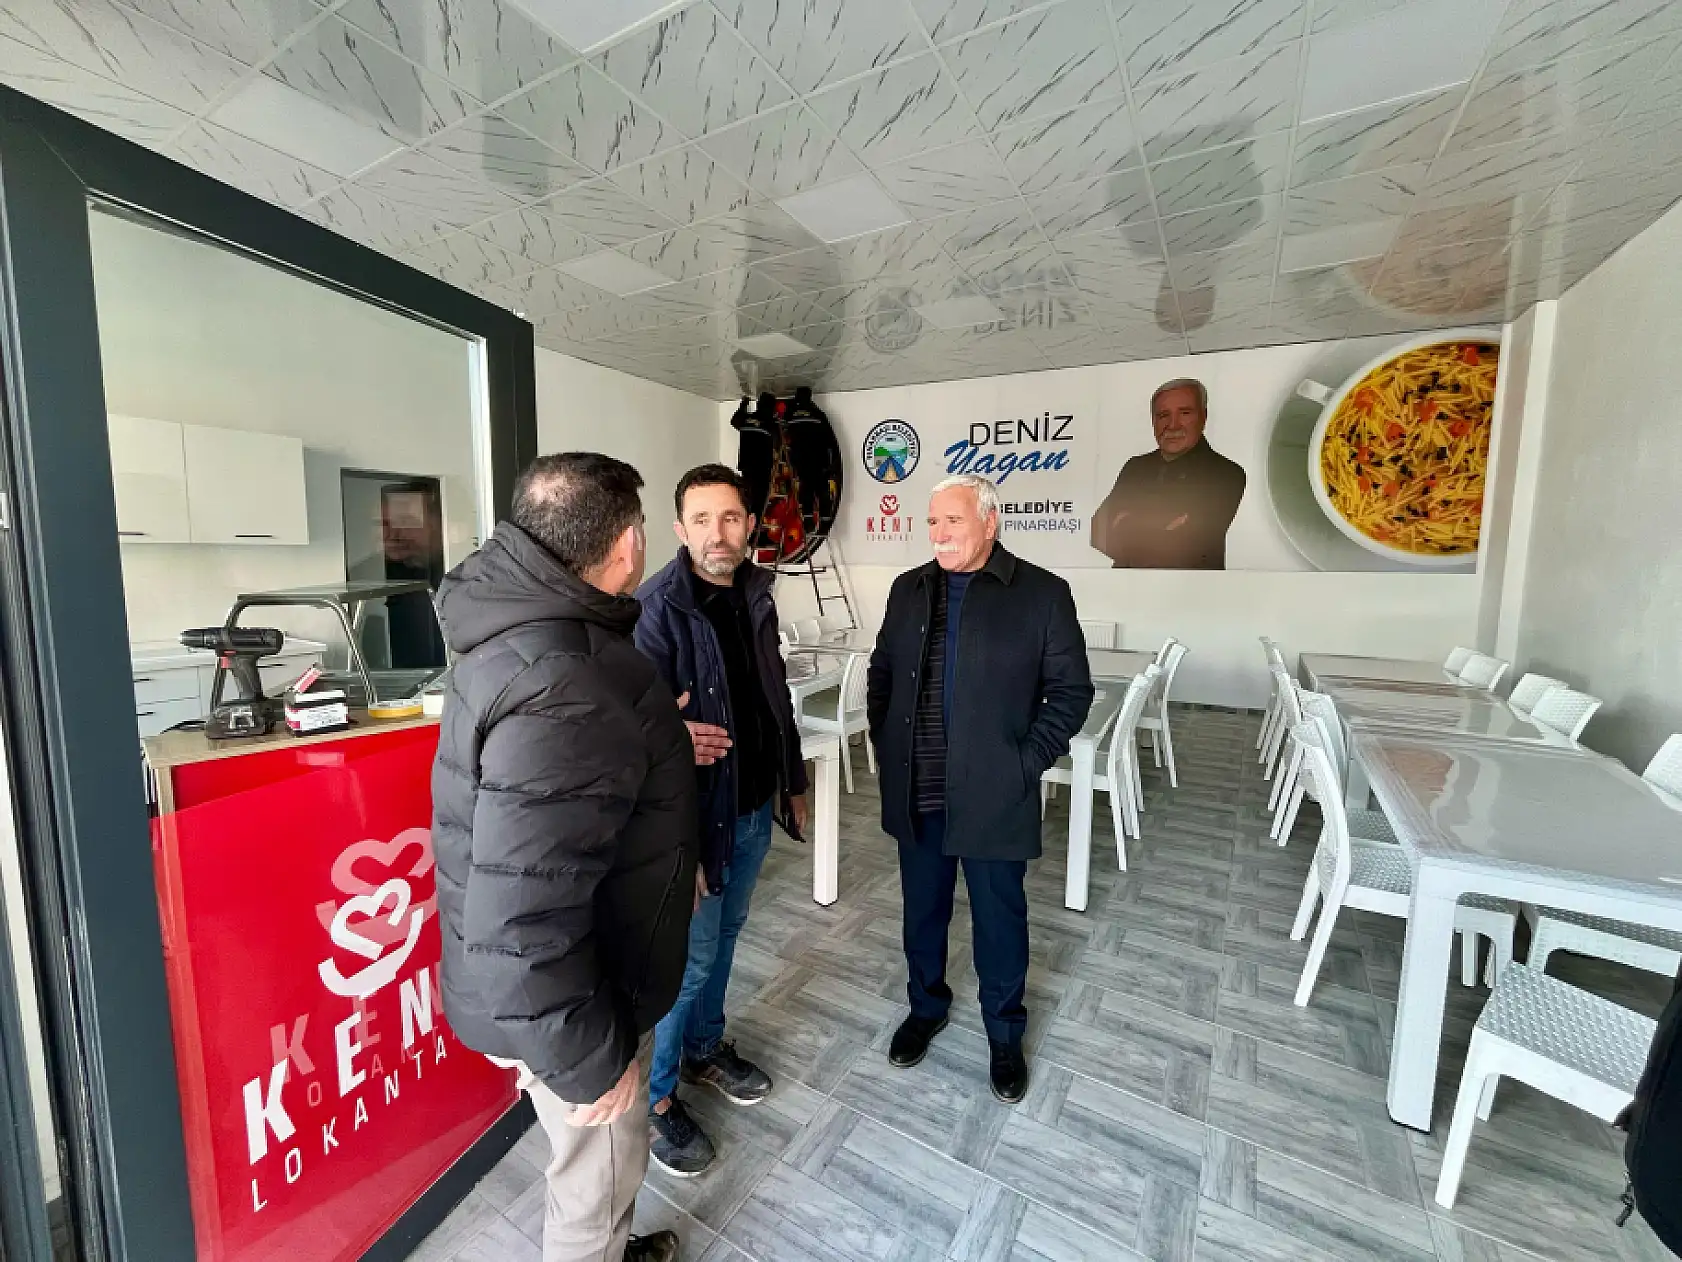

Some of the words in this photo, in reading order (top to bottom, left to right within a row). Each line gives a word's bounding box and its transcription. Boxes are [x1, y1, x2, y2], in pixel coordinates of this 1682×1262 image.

[969, 411, 1074, 447] DENİZ
[943, 439, 1070, 485] Yagan
[866, 516, 914, 533] KENT
[1004, 518, 1081, 534] PINARBAŞI
[242, 966, 433, 1166] KEN
[251, 1036, 447, 1212] LOKANTA
